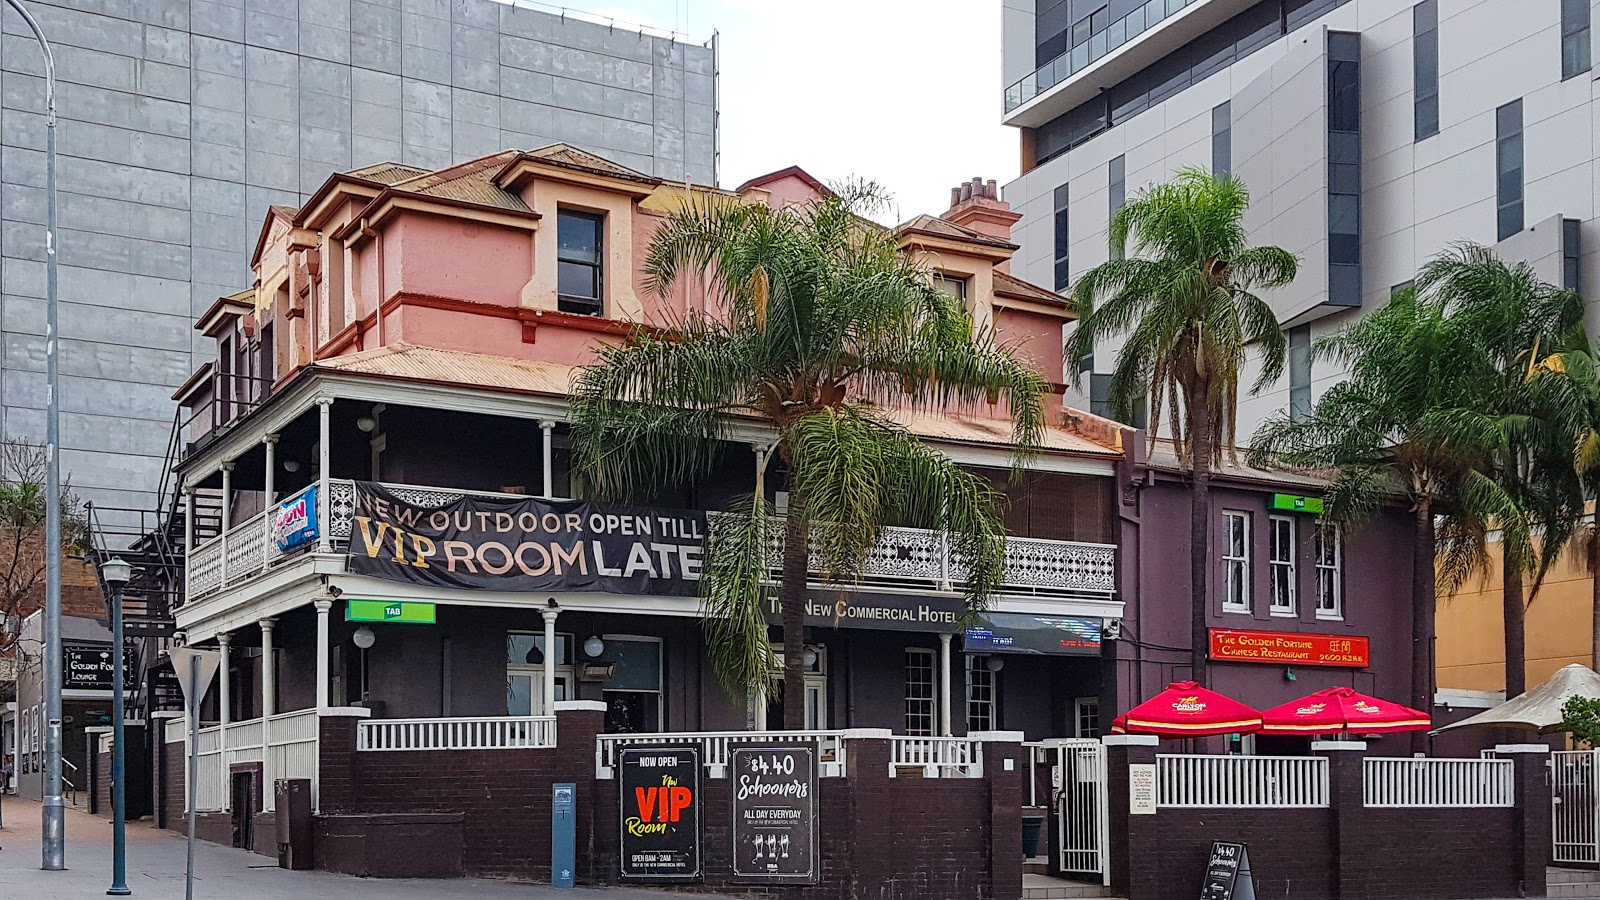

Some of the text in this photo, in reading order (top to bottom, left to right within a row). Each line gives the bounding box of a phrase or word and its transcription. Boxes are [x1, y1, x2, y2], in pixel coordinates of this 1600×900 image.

[356, 494, 704, 539] NEW OUTDOOR OPEN TILL
[354, 515, 705, 581] VIP ROOM LATE
[385, 607, 401, 615] TAB
[1319, 653, 1342, 661] 9600
[639, 756, 678, 768] NOW OPEN
[751, 754, 795, 775] $4.40
[737, 774, 808, 800] Schooners
[635, 786, 692, 823] VIP
[744, 809, 802, 819] ALL DAY EVERYDAY
[625, 816, 667, 837] Room
[631, 854, 644, 862] OPEN
[644, 854, 656, 862] 8AM
[660, 854, 672, 862] 2AM
